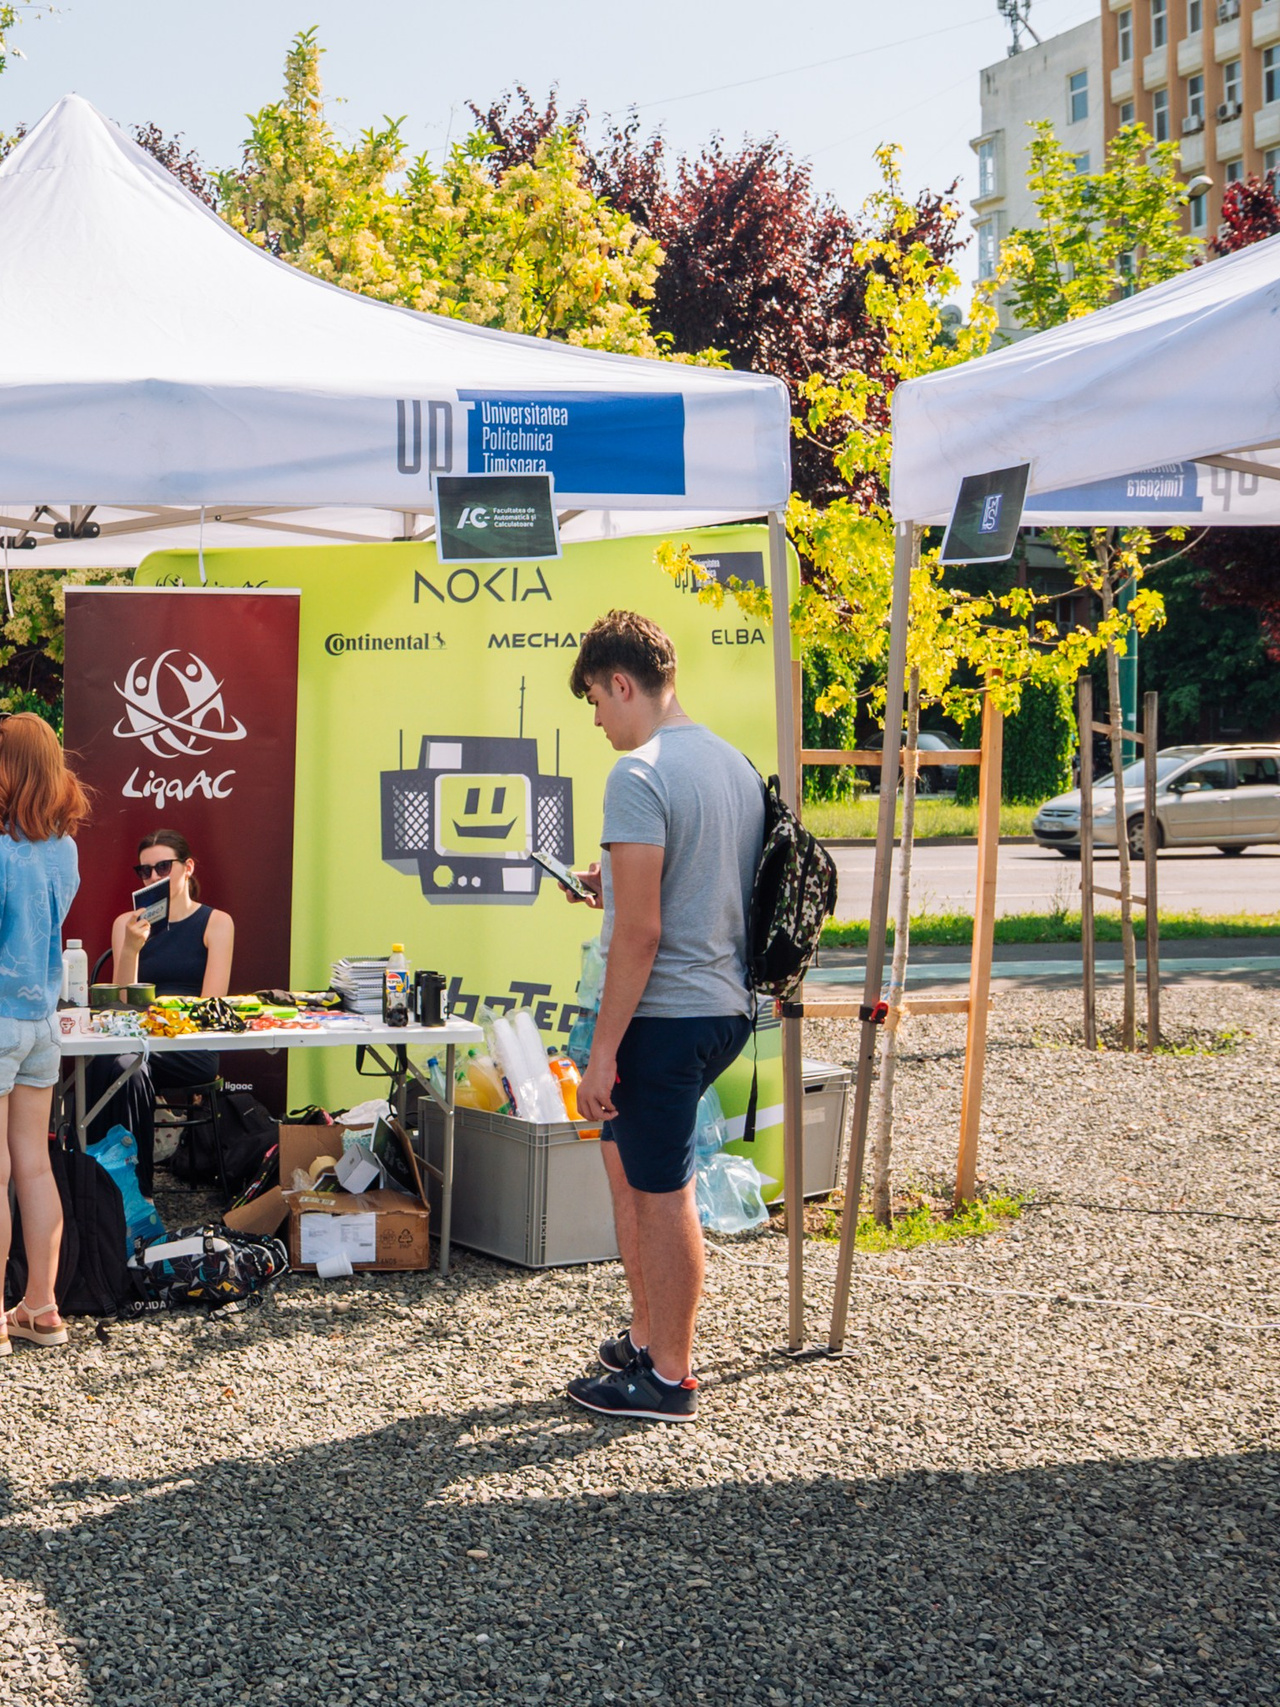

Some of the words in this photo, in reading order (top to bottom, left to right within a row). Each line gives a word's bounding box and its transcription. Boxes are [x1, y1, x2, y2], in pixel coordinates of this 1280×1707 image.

[481, 401, 568, 426] Universitatea
[482, 426, 553, 451] Politehnica
[413, 566, 552, 604] NOKIA
[324, 633, 430, 656] Continental
[711, 628, 766, 645] ELBA
[122, 766, 237, 810] LigaAC
[224, 1081, 253, 1092] ligaac
